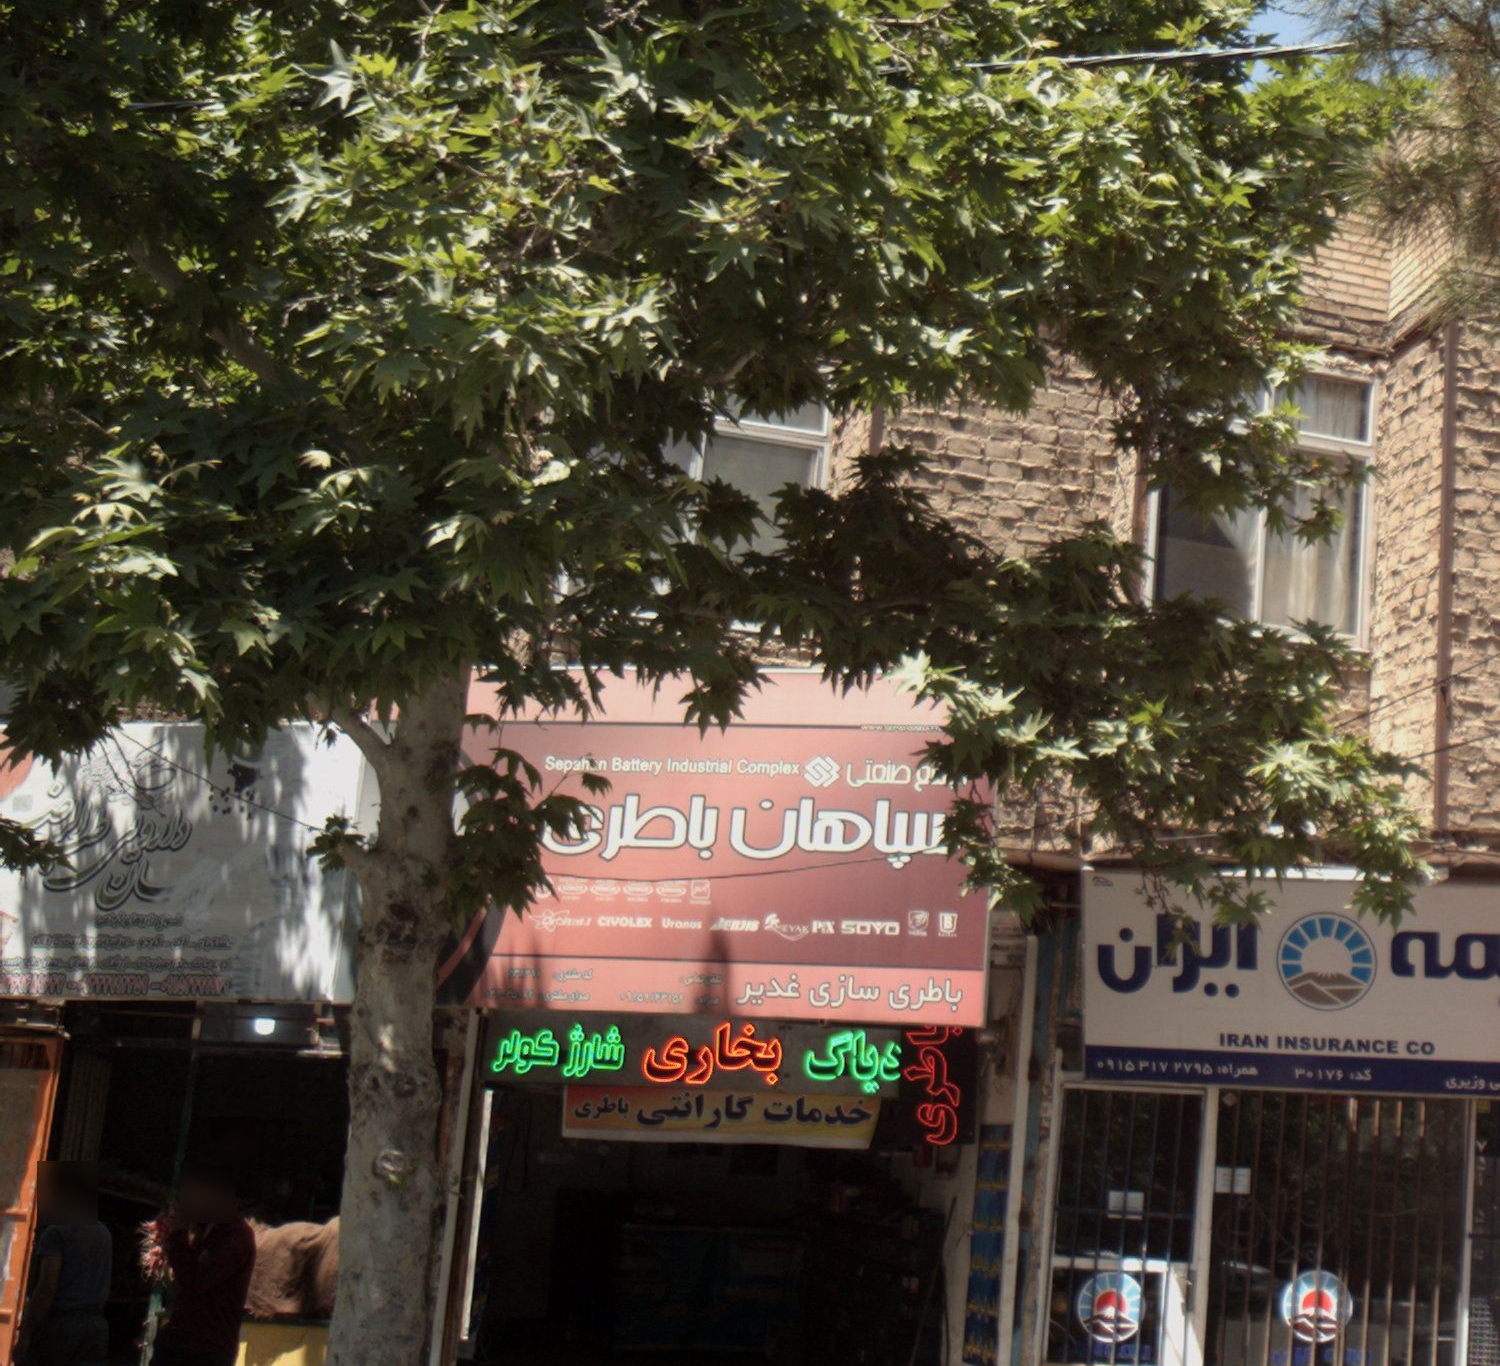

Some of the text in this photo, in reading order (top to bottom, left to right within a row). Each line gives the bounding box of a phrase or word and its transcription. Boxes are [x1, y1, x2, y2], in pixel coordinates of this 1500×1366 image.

[611, 756, 662, 776] Battery
[667, 758, 733, 774] Industrial
[736, 759, 800, 777] Complex
[846, 760, 912, 787] صنعتی
[540, 793, 719, 862] باطری
[597, 915, 653, 928] CIVOLEX
[661, 917, 703, 930] Uranus
[840, 919, 901, 936] SOYO
[1097, 913, 1259, 998] ایران
[736, 973, 963, 1012] باطری سازی غدیر
[491, 1026, 560, 1074] کولر
[562, 1021, 626, 1077] شارژ
[642, 1021, 783, 1086] بخاری
[1219, 1033, 1436, 1055] IRAN INSURANCE CO
[1445, 1074, 1486, 1089] وزیری
[574, 1096, 630, 1119] باطری
[762, 1096, 872, 1125] خدمات
